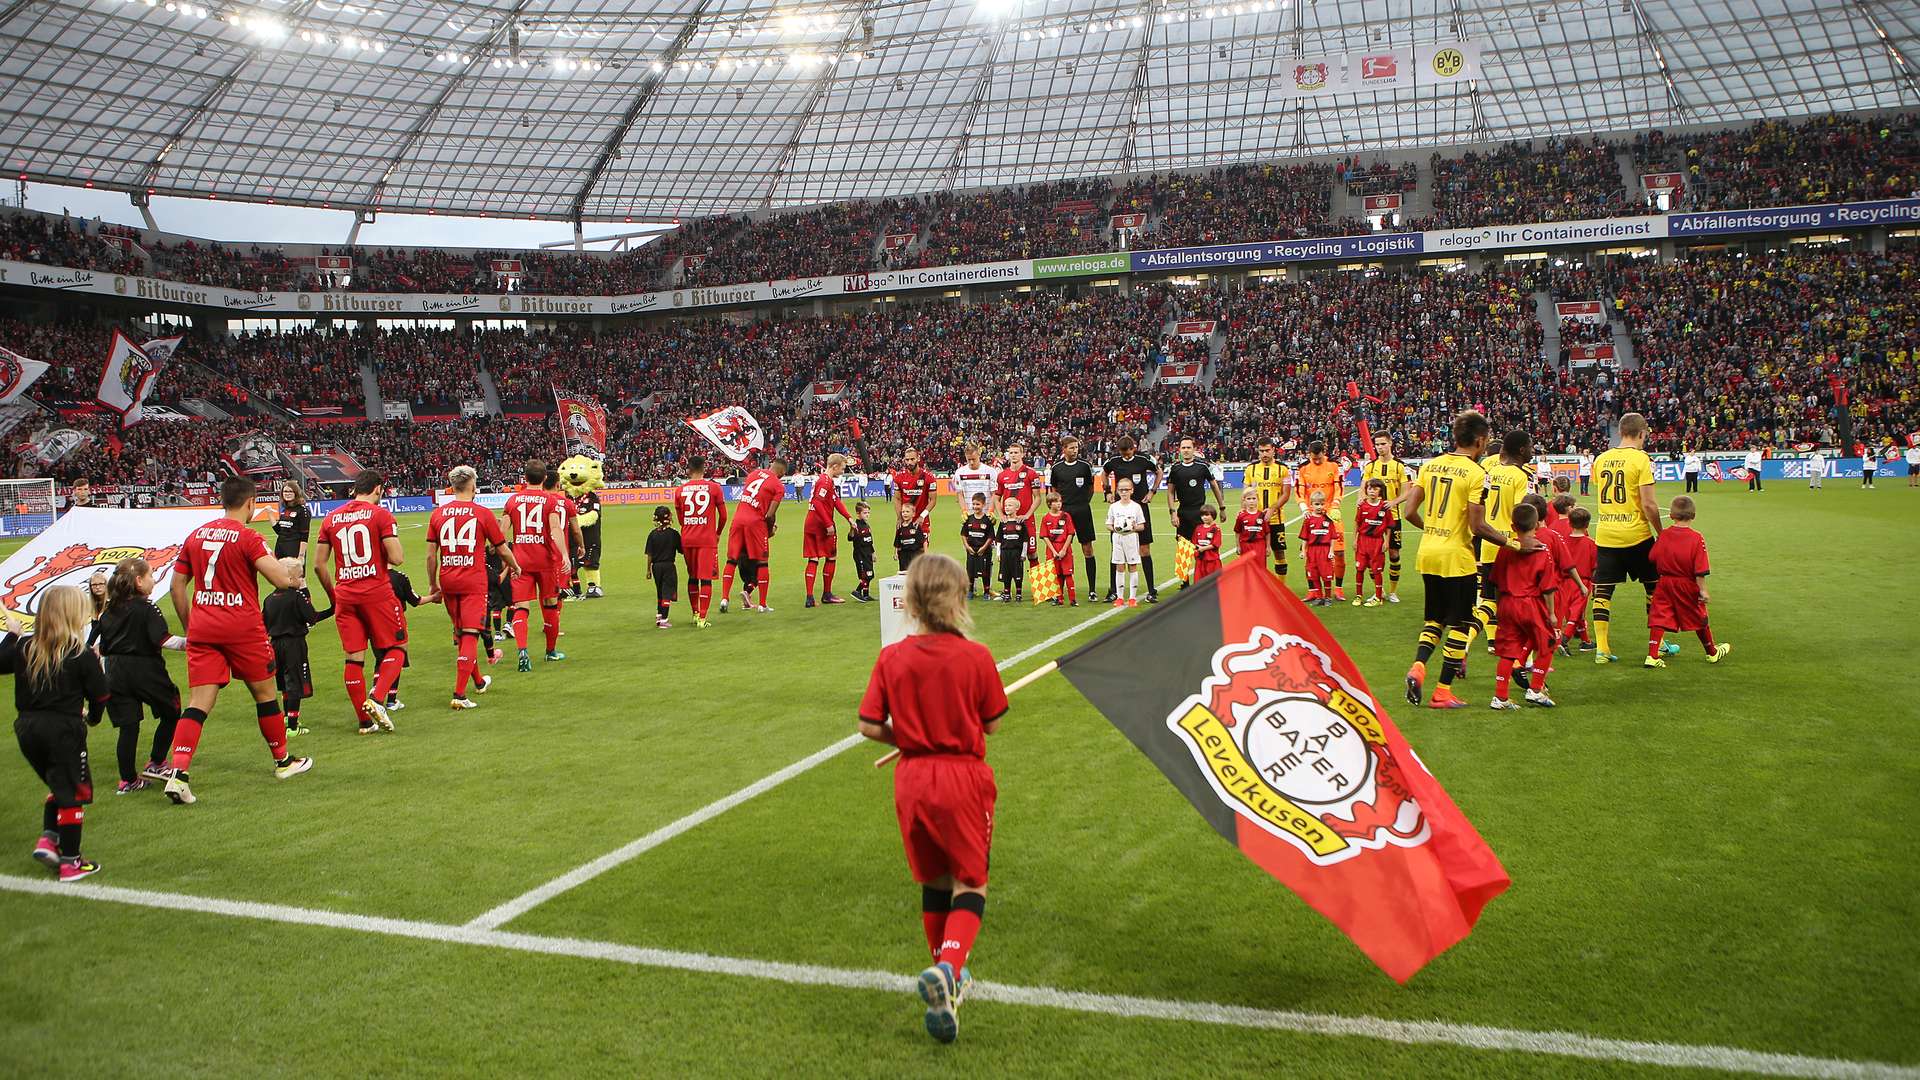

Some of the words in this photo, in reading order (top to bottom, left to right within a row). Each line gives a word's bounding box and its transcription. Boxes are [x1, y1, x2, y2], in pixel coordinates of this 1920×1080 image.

[1437, 51, 1460, 69] BVB
[1681, 212, 1821, 231] Abfallentsorgung
[1837, 204, 1920, 222] Recycling
[1439, 232, 1481, 247] reloga
[1496, 231, 1517, 243] Ihr
[1521, 221, 1650, 241] Containerdienst
[1147, 248, 1262, 266] Abfallentsorgung
[1274, 242, 1342, 258] Recycling
[1358, 237, 1415, 254] Logistik
[898, 274, 915, 286] Ihr
[917, 266, 1019, 284] Containerdienst
[1037, 257, 1125, 273] www.reloga.de
[136, 278, 208, 305] Bitburger
[322, 294, 403, 311] Bitburger
[690, 288, 757, 306] Bitburger
[520, 297, 593, 313] Bitburger
[515, 495, 547, 504] MEHMEDI
[746, 478, 765, 498] 4
[1426, 475, 1453, 519] 17
[1600, 469, 1627, 504] 28
[306, 501, 325, 516] VL
[442, 507, 474, 517] KAMPL
[680, 490, 710, 517] 39
[1490, 485, 1501, 521] 7
[517, 502, 544, 534] 14
[335, 523, 373, 567] 10
[439, 516, 478, 553] 44
[201, 540, 226, 590] 7
[362, 564, 377, 577] 04
[226, 592, 243, 606] 04
[1337, 694, 1381, 739] 1904
[1193, 718, 1326, 844] Leverkusen
